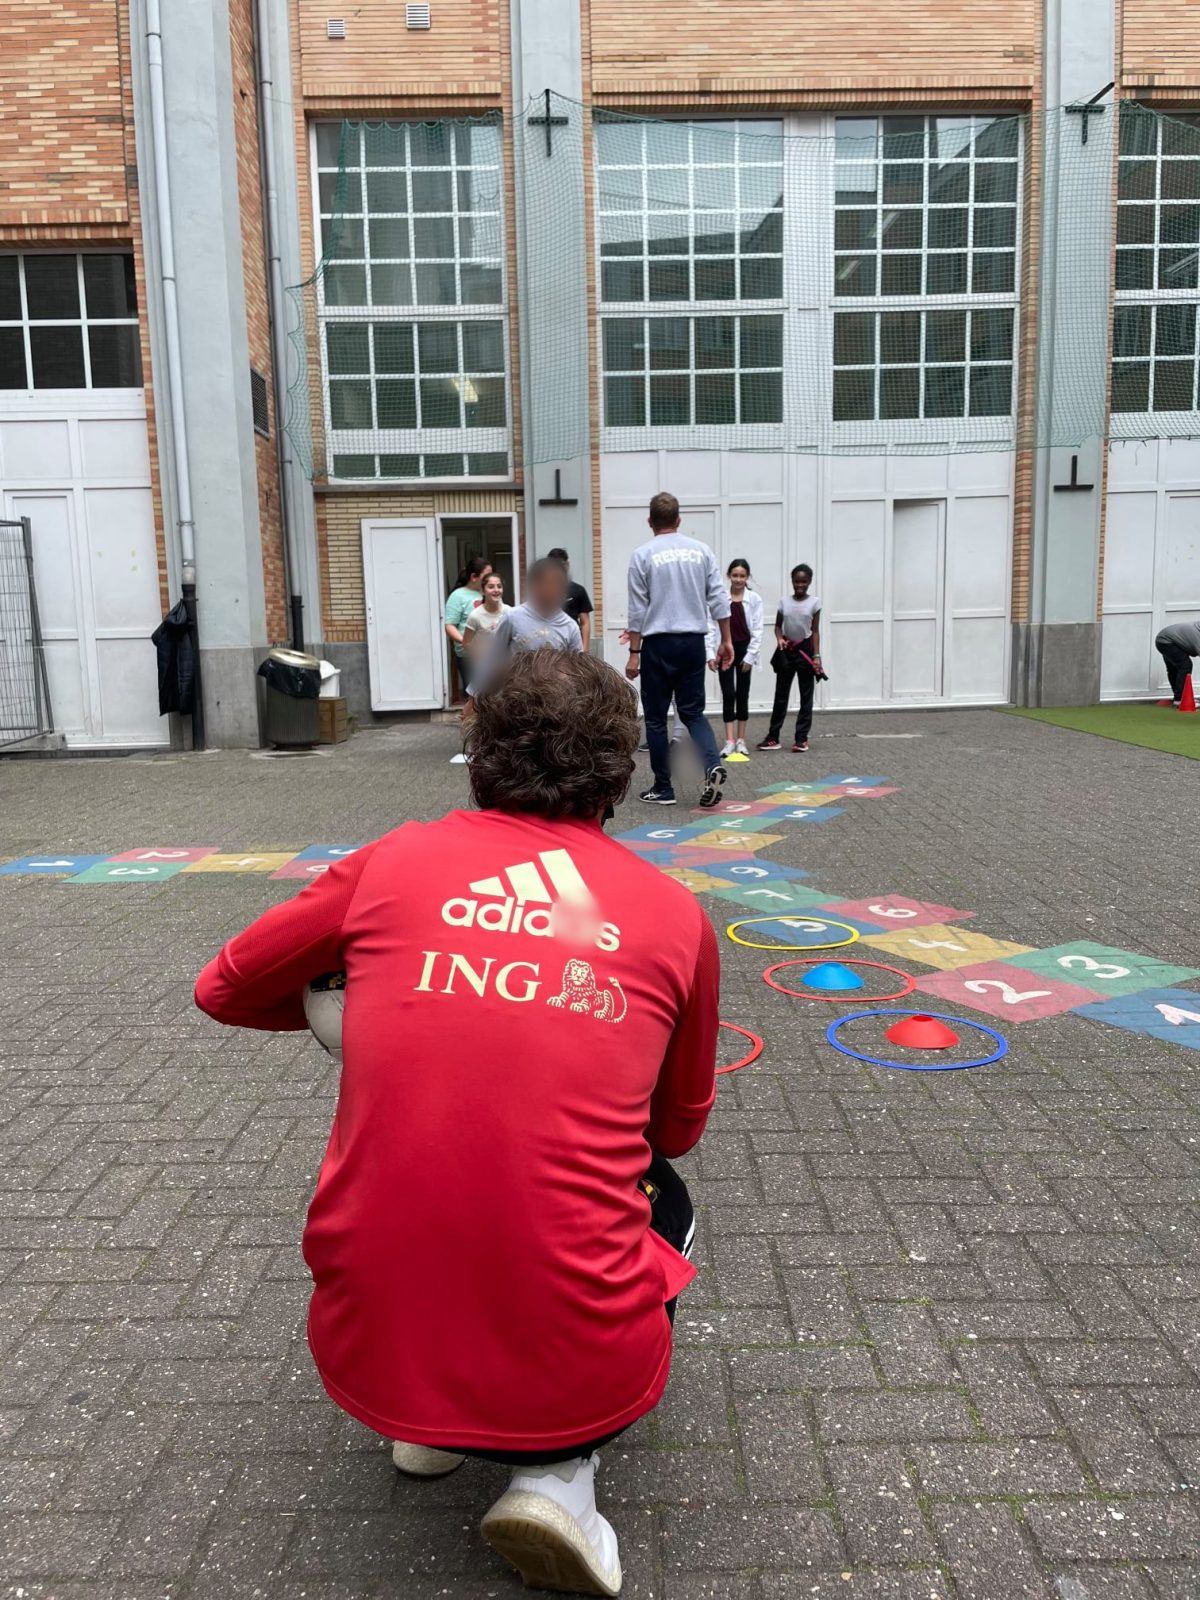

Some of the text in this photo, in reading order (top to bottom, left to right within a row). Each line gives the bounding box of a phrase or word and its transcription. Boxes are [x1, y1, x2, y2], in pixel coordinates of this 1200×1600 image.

[441, 896, 621, 952] adids
[413, 950, 543, 1003] ING
[1056, 954, 1132, 980] 3
[963, 978, 1053, 1005] 2
